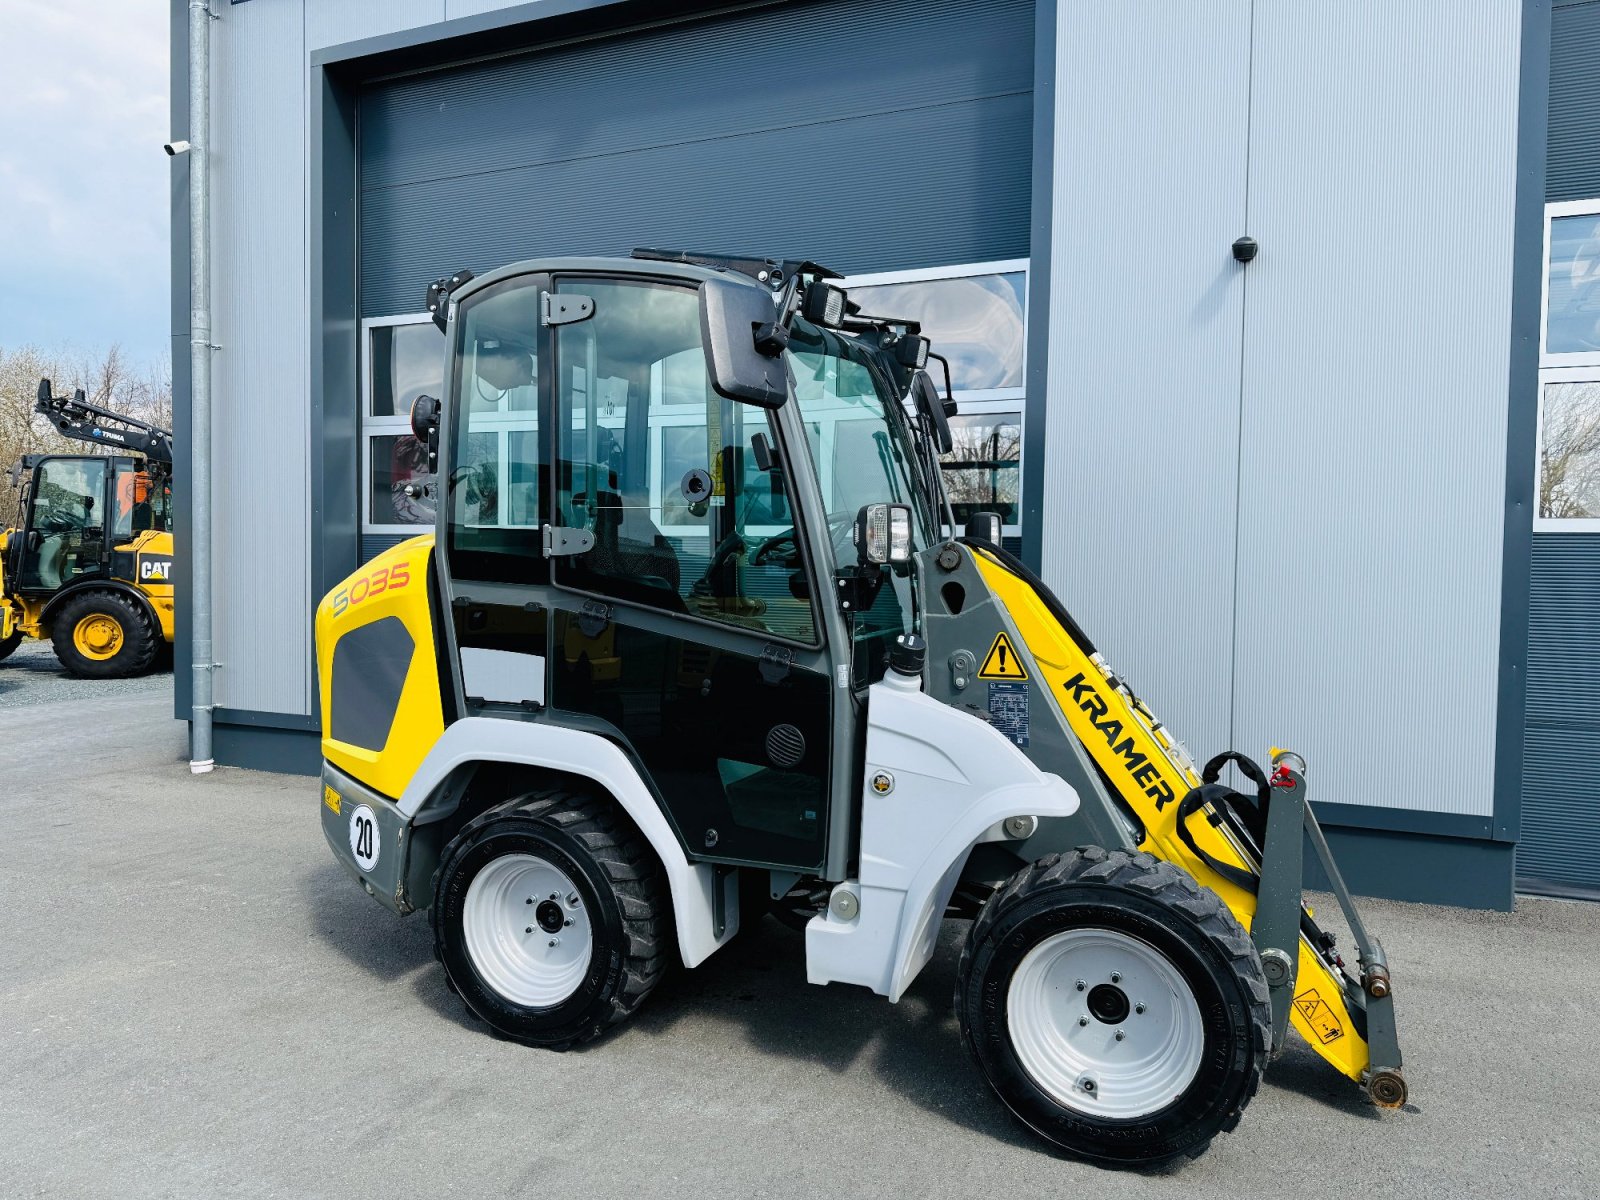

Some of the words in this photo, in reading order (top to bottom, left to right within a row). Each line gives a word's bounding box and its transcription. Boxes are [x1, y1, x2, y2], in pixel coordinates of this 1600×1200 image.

[141, 561, 172, 580] CAT
[333, 562, 410, 618] 5035
[1063, 672, 1175, 813] KRAMER
[356, 815, 373, 860] 20
